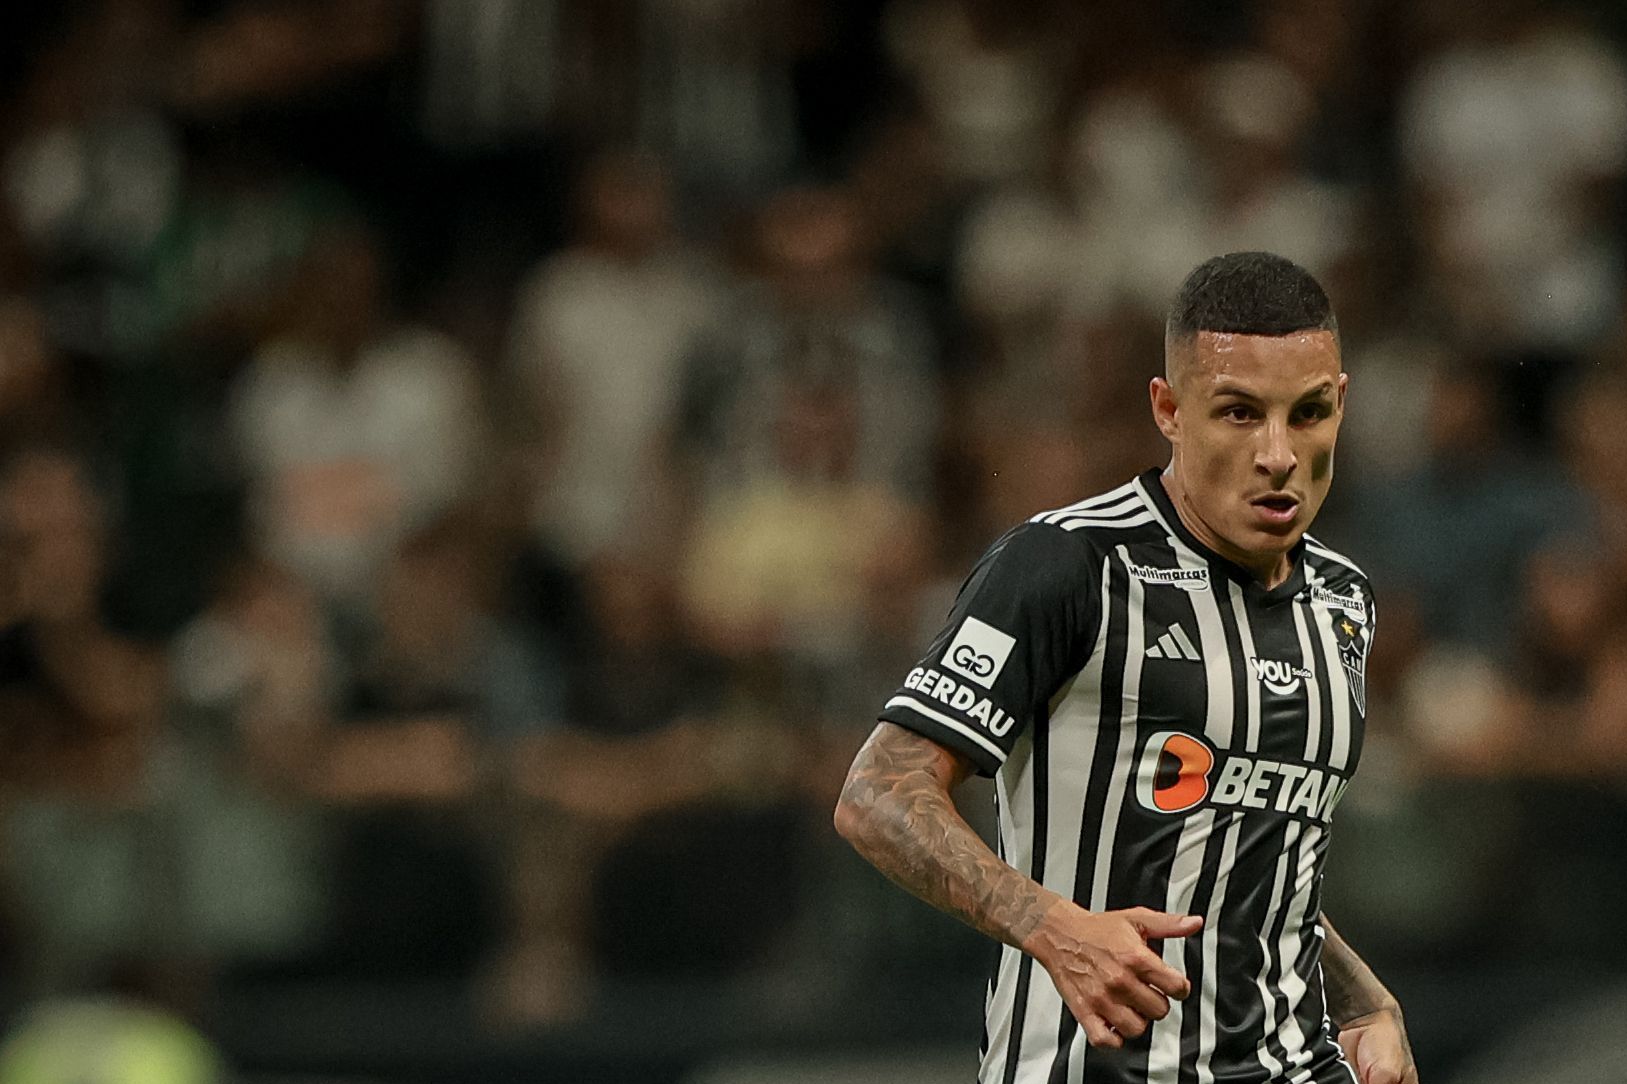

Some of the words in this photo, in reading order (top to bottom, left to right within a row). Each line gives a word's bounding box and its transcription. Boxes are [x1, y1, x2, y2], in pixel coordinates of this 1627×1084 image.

[1128, 565, 1208, 580] Multimarcas
[1251, 658, 1292, 684] YOU
[903, 667, 1016, 738] GERDAU
[1210, 756, 1350, 824] BETAN
